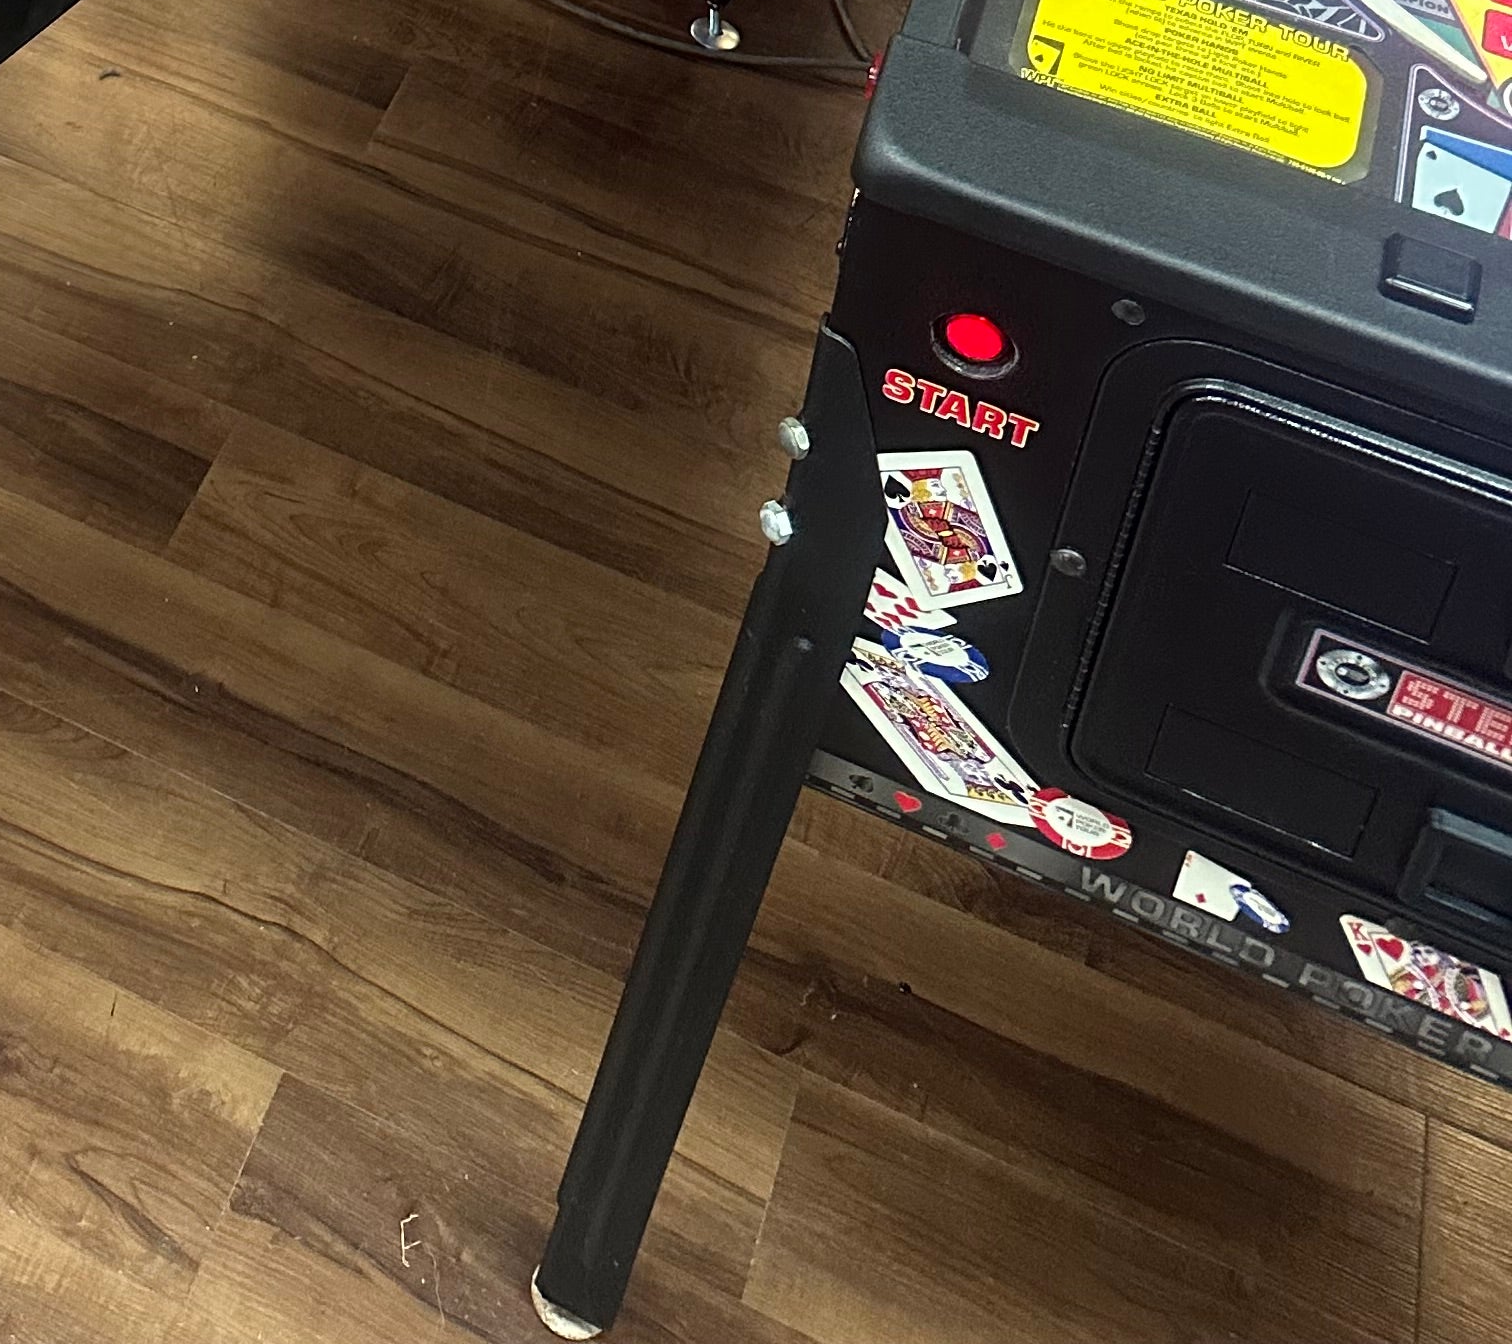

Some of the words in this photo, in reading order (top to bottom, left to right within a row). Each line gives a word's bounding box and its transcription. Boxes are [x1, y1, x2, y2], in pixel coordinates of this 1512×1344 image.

[1164, 5, 1197, 20] TEXAS
[1199, 14, 1227, 29] HOLD
[1163, 26, 1200, 43] POKER
[1200, 38, 1239, 56] HANDS
[1278, 22, 1351, 62] TOUR
[1138, 64, 1155, 75] NO
[1156, 70, 1185, 85] LIMIT
[1185, 79, 1244, 104] MULTIBALL
[1210, 64, 1269, 89] MULTIBALL
[1154, 92, 1190, 110] EXTRA
[1190, 104, 1217, 119] BALL
[881, 368, 1040, 449] START
[1074, 824, 1100, 838] TOUR
[1075, 814, 1110, 829] WORLD
[1075, 819, 1108, 834] POKER
[1349, 922, 1368, 943] K
[1080, 866, 1276, 968] WORLD
[1297, 962, 1494, 1059] POKER
